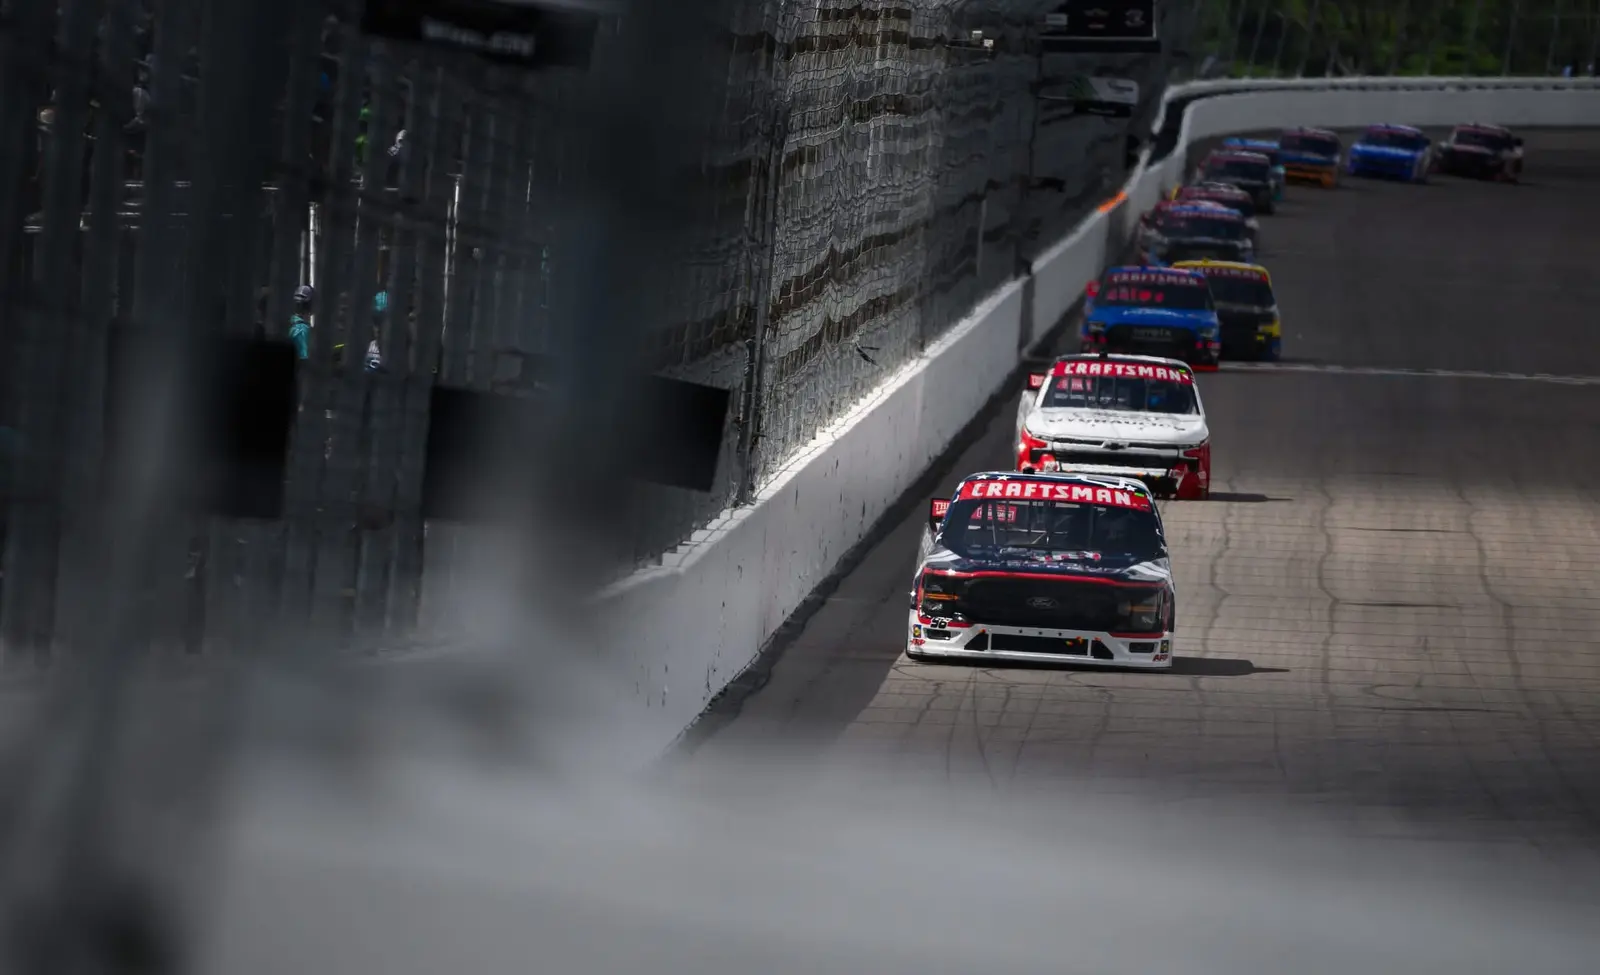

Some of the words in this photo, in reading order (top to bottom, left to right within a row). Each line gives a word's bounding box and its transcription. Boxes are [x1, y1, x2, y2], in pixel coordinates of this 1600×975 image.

[1112, 273, 1198, 285] CRAFTSMAN
[1064, 362, 1180, 381] CRAFTSMAN
[971, 482, 1132, 506] CRAFTSMAN
